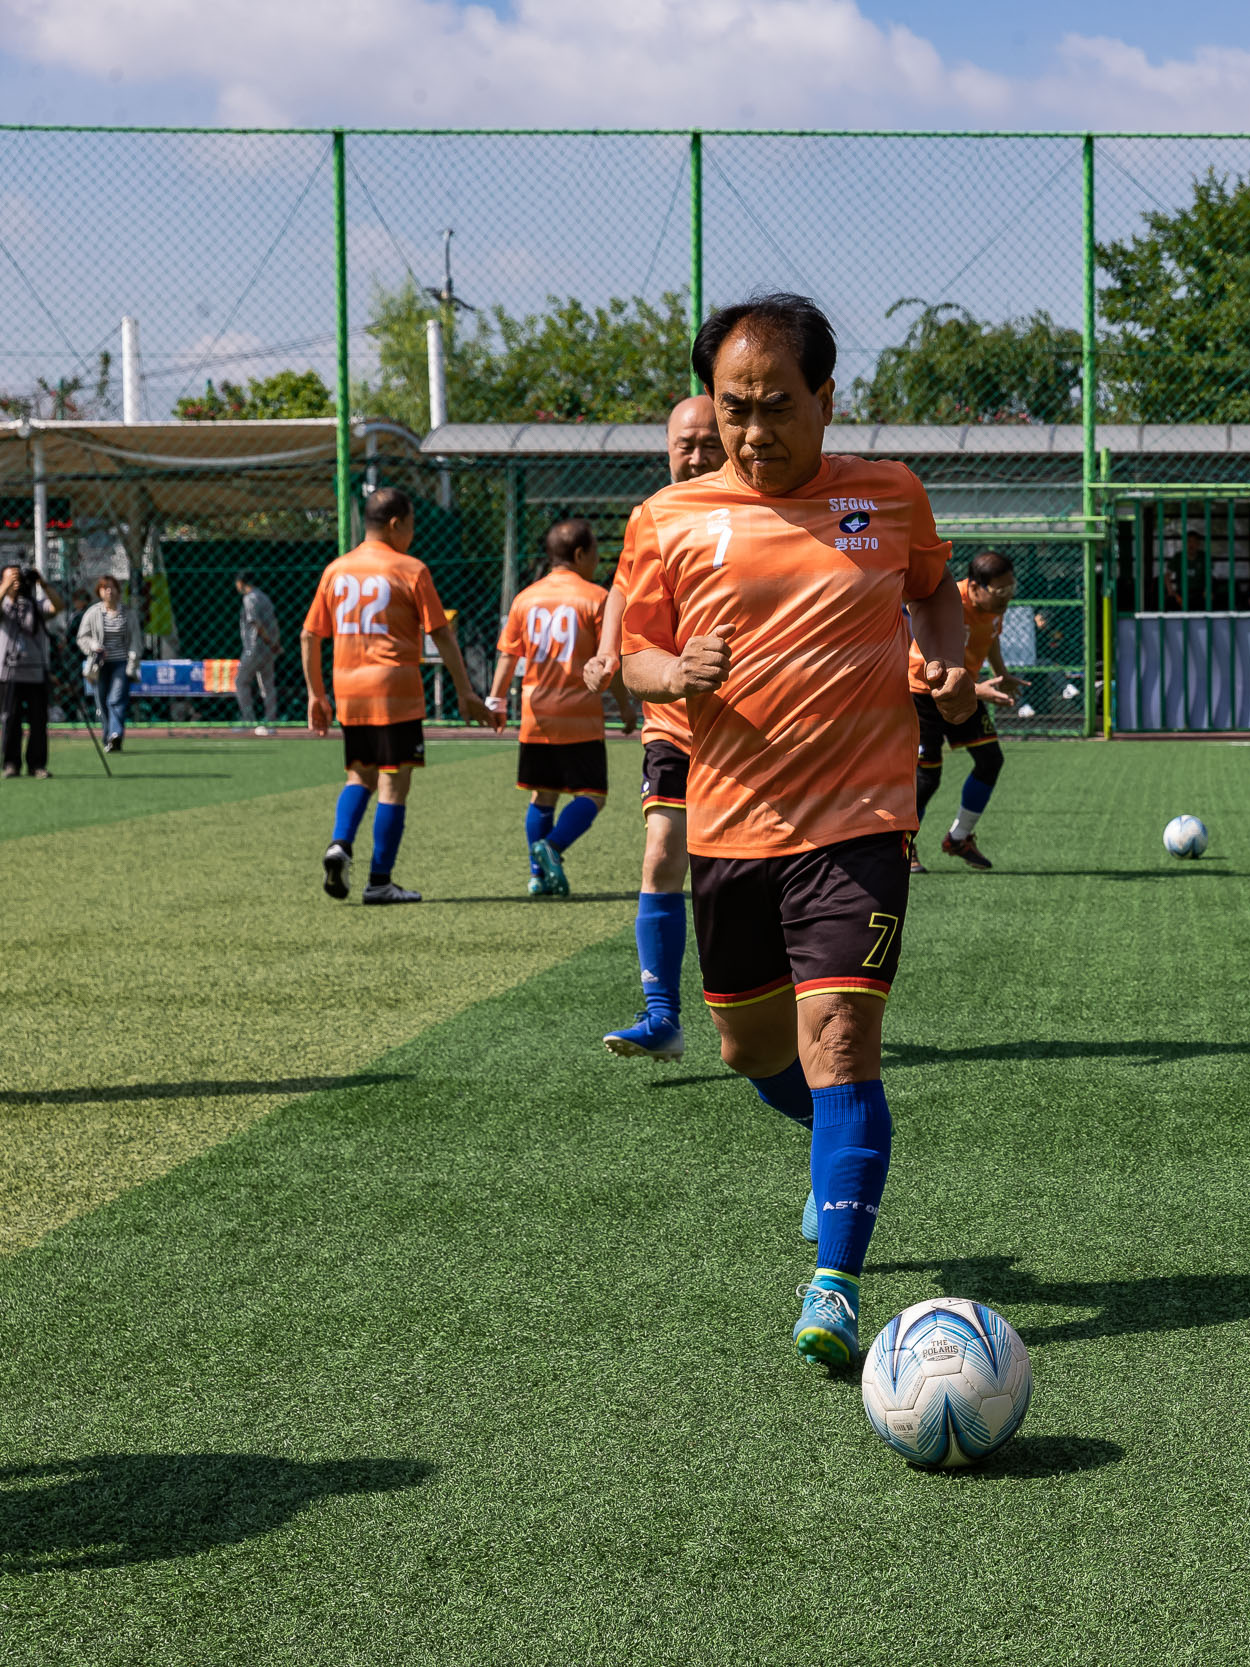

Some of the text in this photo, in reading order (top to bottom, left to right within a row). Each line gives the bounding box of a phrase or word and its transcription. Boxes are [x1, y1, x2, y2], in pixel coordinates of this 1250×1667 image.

[828, 497, 878, 512] SEOUL
[707, 525, 733, 568] 7
[834, 537, 879, 551] 광진70
[334, 574, 391, 635] 22
[861, 912, 898, 968] 7
[931, 1339, 948, 1347] THE
[922, 1345, 959, 1359] POLARIS
